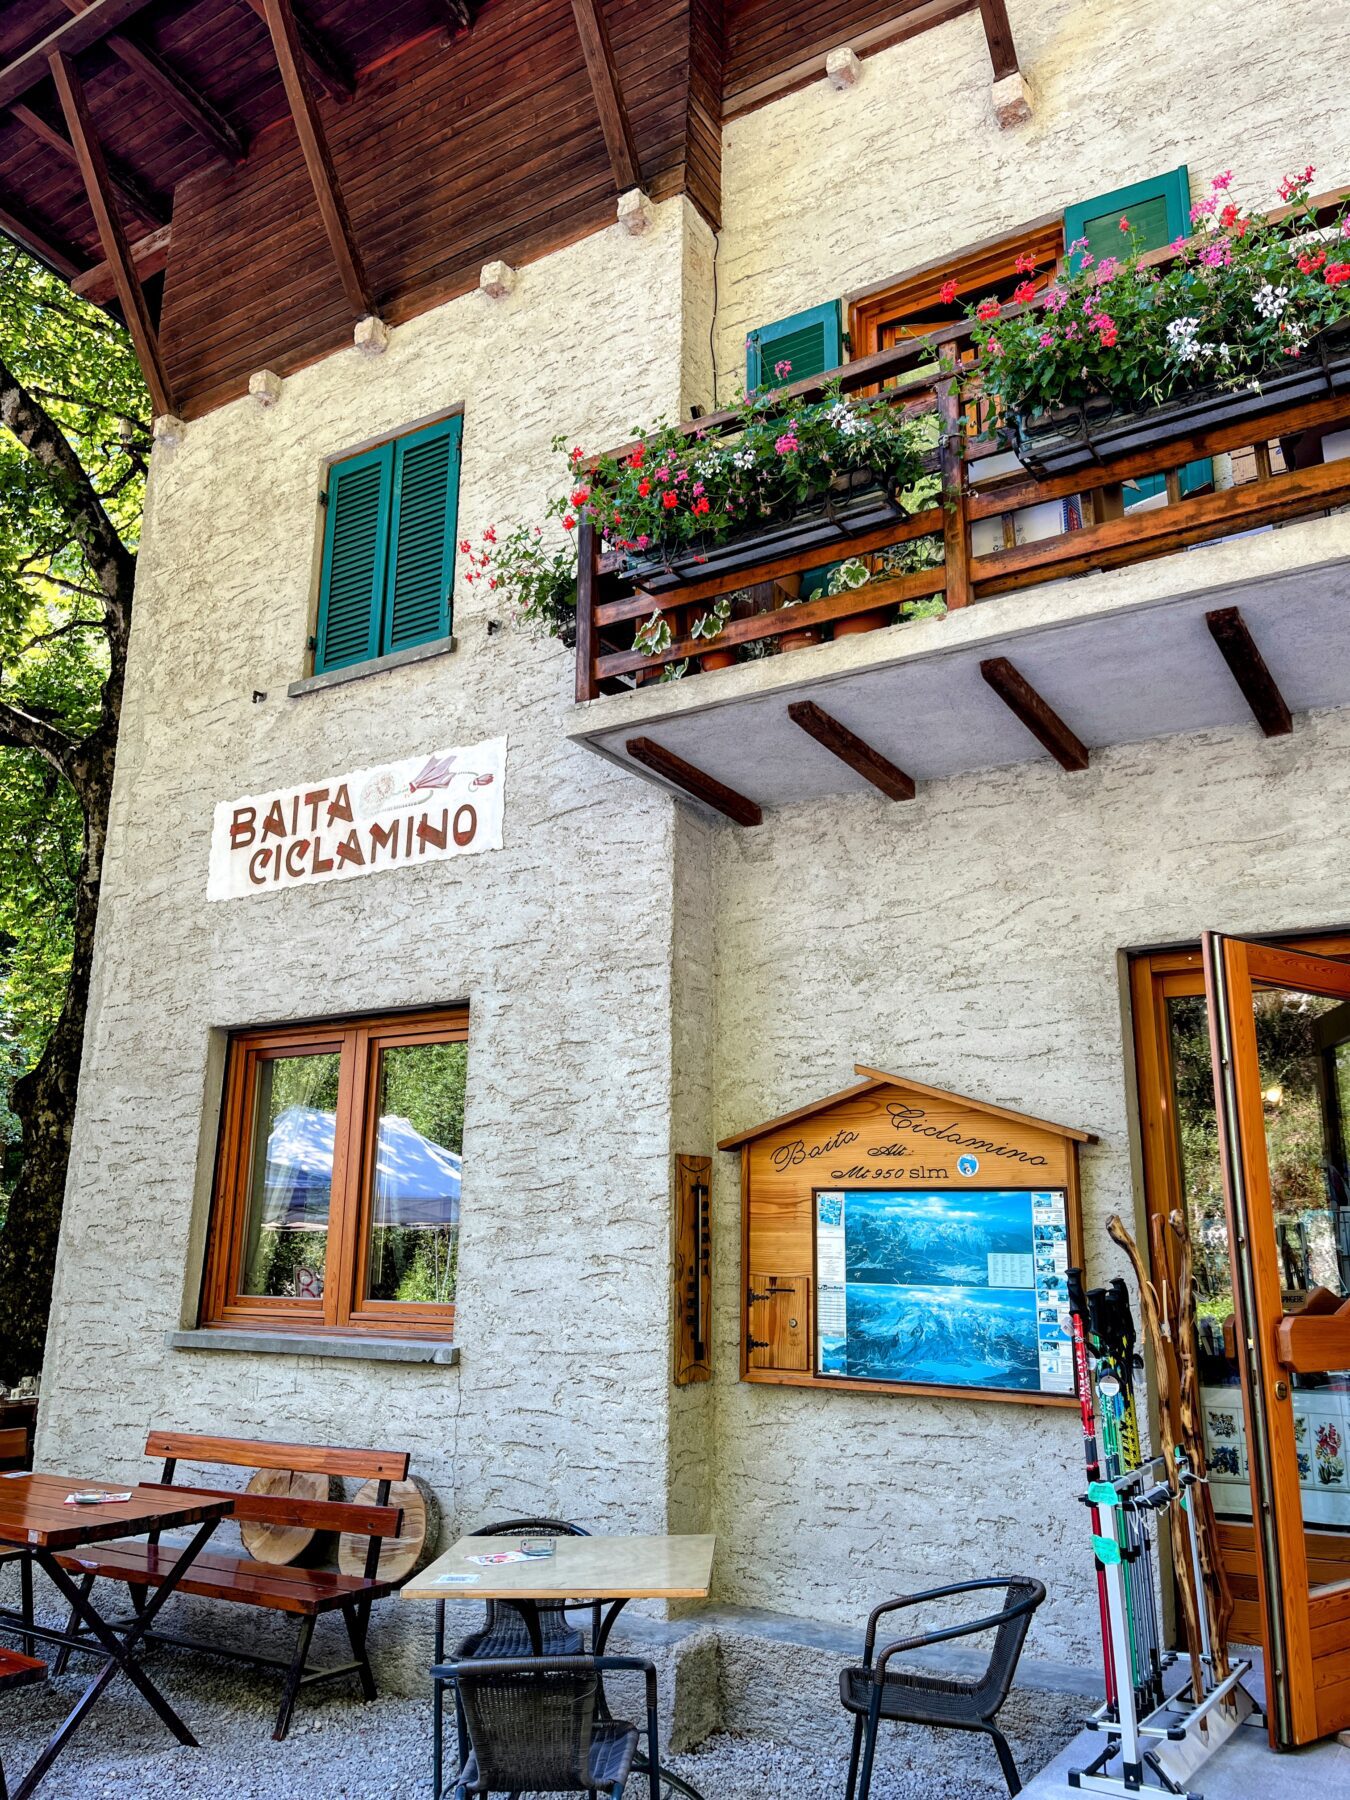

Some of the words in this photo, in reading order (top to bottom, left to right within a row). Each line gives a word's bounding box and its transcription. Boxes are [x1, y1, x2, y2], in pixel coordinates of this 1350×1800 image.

[230, 783, 353, 849] BAITA
[249, 804, 477, 884] CICLAMINO
[770, 1129, 859, 1173] Baita
[886, 1103, 1048, 1165] Ciclamino
[872, 1168, 904, 1179] 950
[909, 1166, 949, 1179] slm
